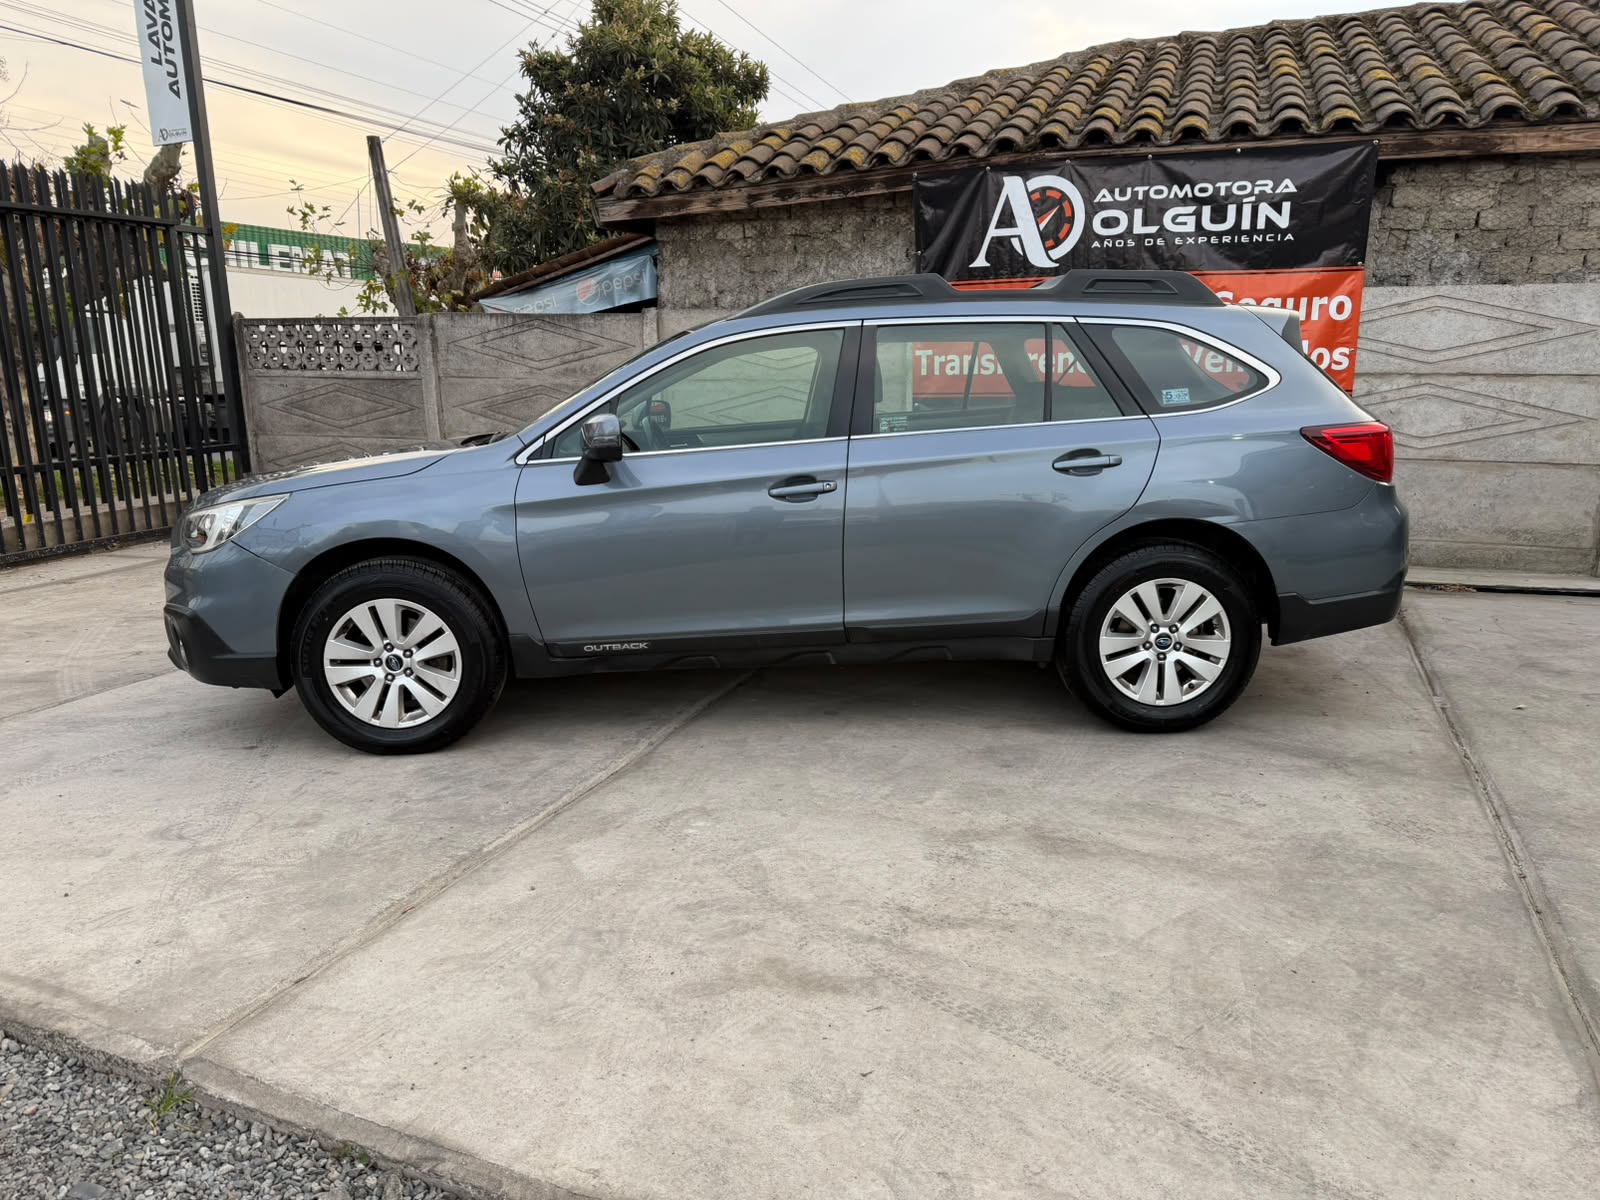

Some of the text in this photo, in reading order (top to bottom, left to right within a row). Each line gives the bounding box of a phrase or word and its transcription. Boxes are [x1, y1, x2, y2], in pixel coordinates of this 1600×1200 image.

[1093, 178, 1298, 202] AUTOMOTORA
[1091, 195, 1291, 236] OLGUÍN
[1091, 233, 1295, 249] AÑOS DE EXPERIENCIA
[601, 271, 648, 296] pepsi
[583, 642, 649, 652] OUTBACK
